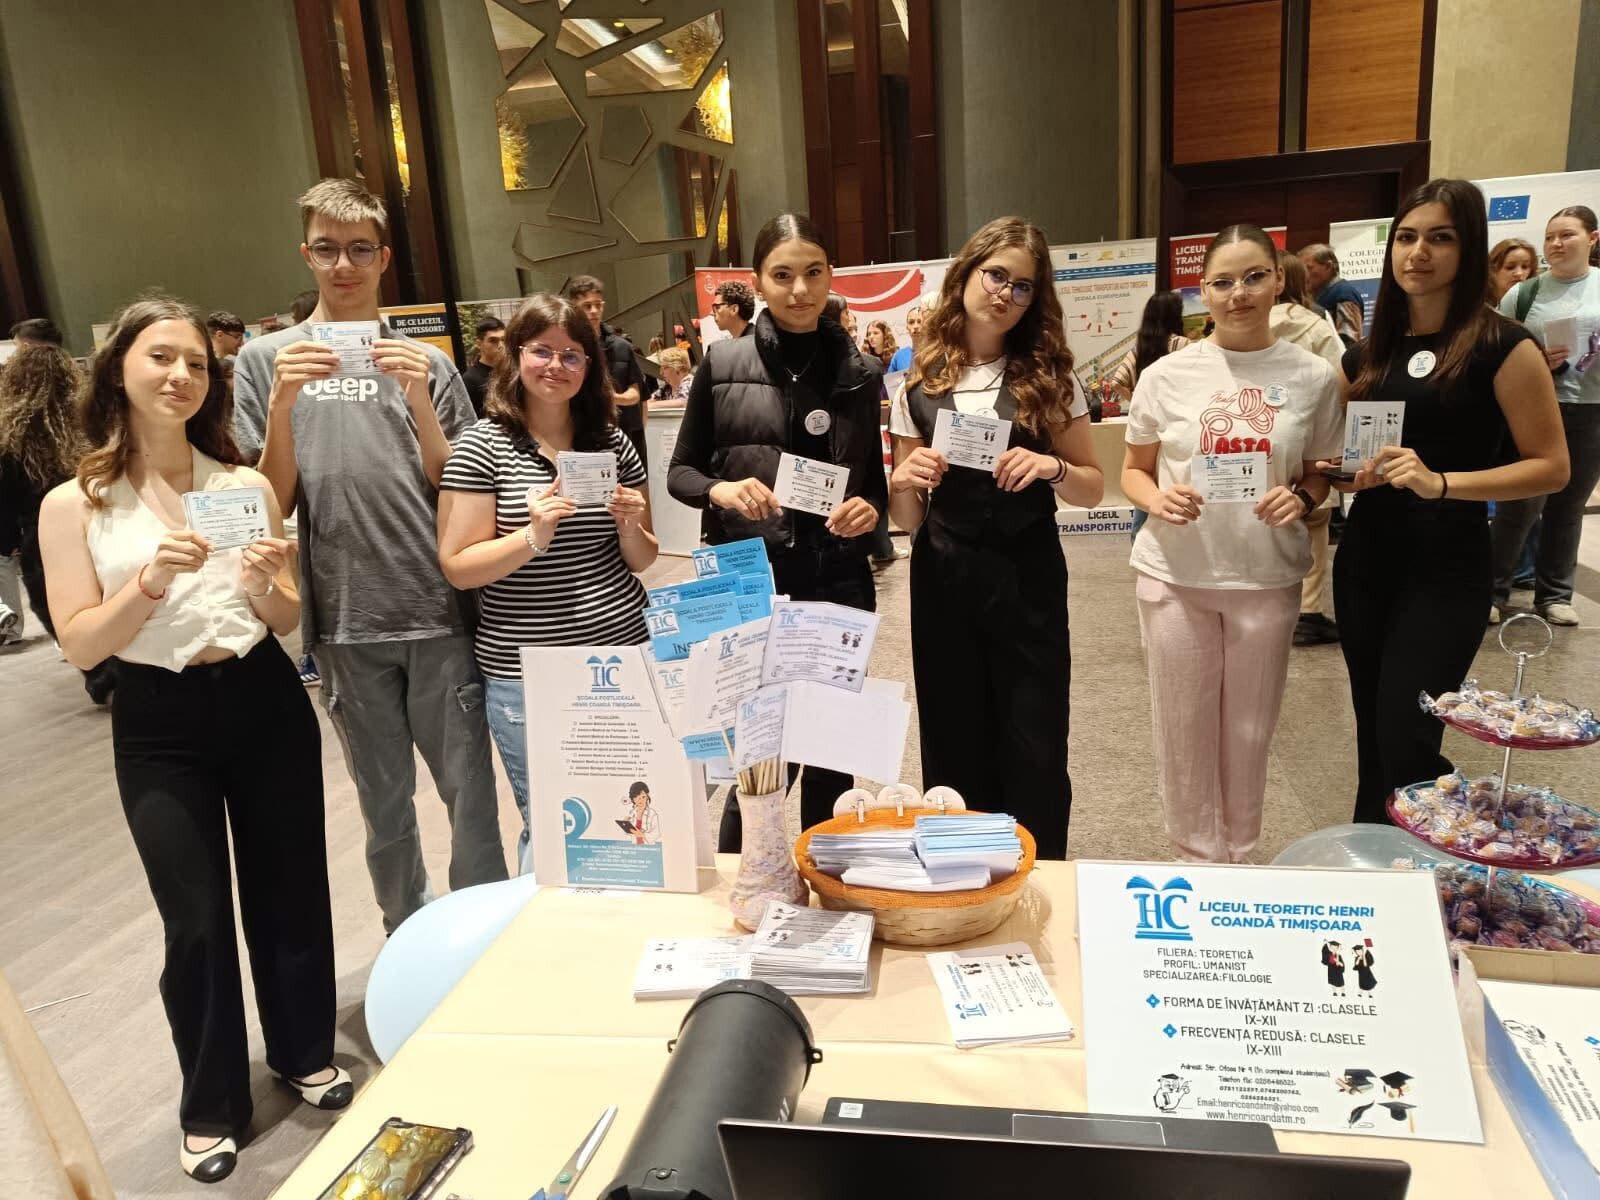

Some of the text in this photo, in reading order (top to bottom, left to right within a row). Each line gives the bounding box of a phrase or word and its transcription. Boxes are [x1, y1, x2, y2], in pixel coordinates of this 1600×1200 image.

[1176, 245, 1207, 255] LICEUL
[407, 318, 416, 326] CE
[417, 317, 443, 325] LICEUL
[303, 377, 379, 402] Jeep
[1088, 511, 1120, 519] LICEUL
[1057, 522, 1132, 533] TRANSPORTUR
[1199, 901, 1375, 918] LICEUL TEORETIC HENRI
[1211, 914, 1362, 933] COANDĂ TIMIȘOARA
[1157, 947, 1197, 958] FILIERA:
[1163, 959, 1247, 971] PROFIL: UMANIST
[1163, 996, 1204, 1009] FORMA
[1207, 998, 1222, 1009] DE
[1303, 1002, 1314, 1014] ZI
[1245, 1014, 1277, 1026] IX-XII
[1310, 1032, 1366, 1046] CLASELE
[1246, 1044, 1282, 1056] IX-XIII
